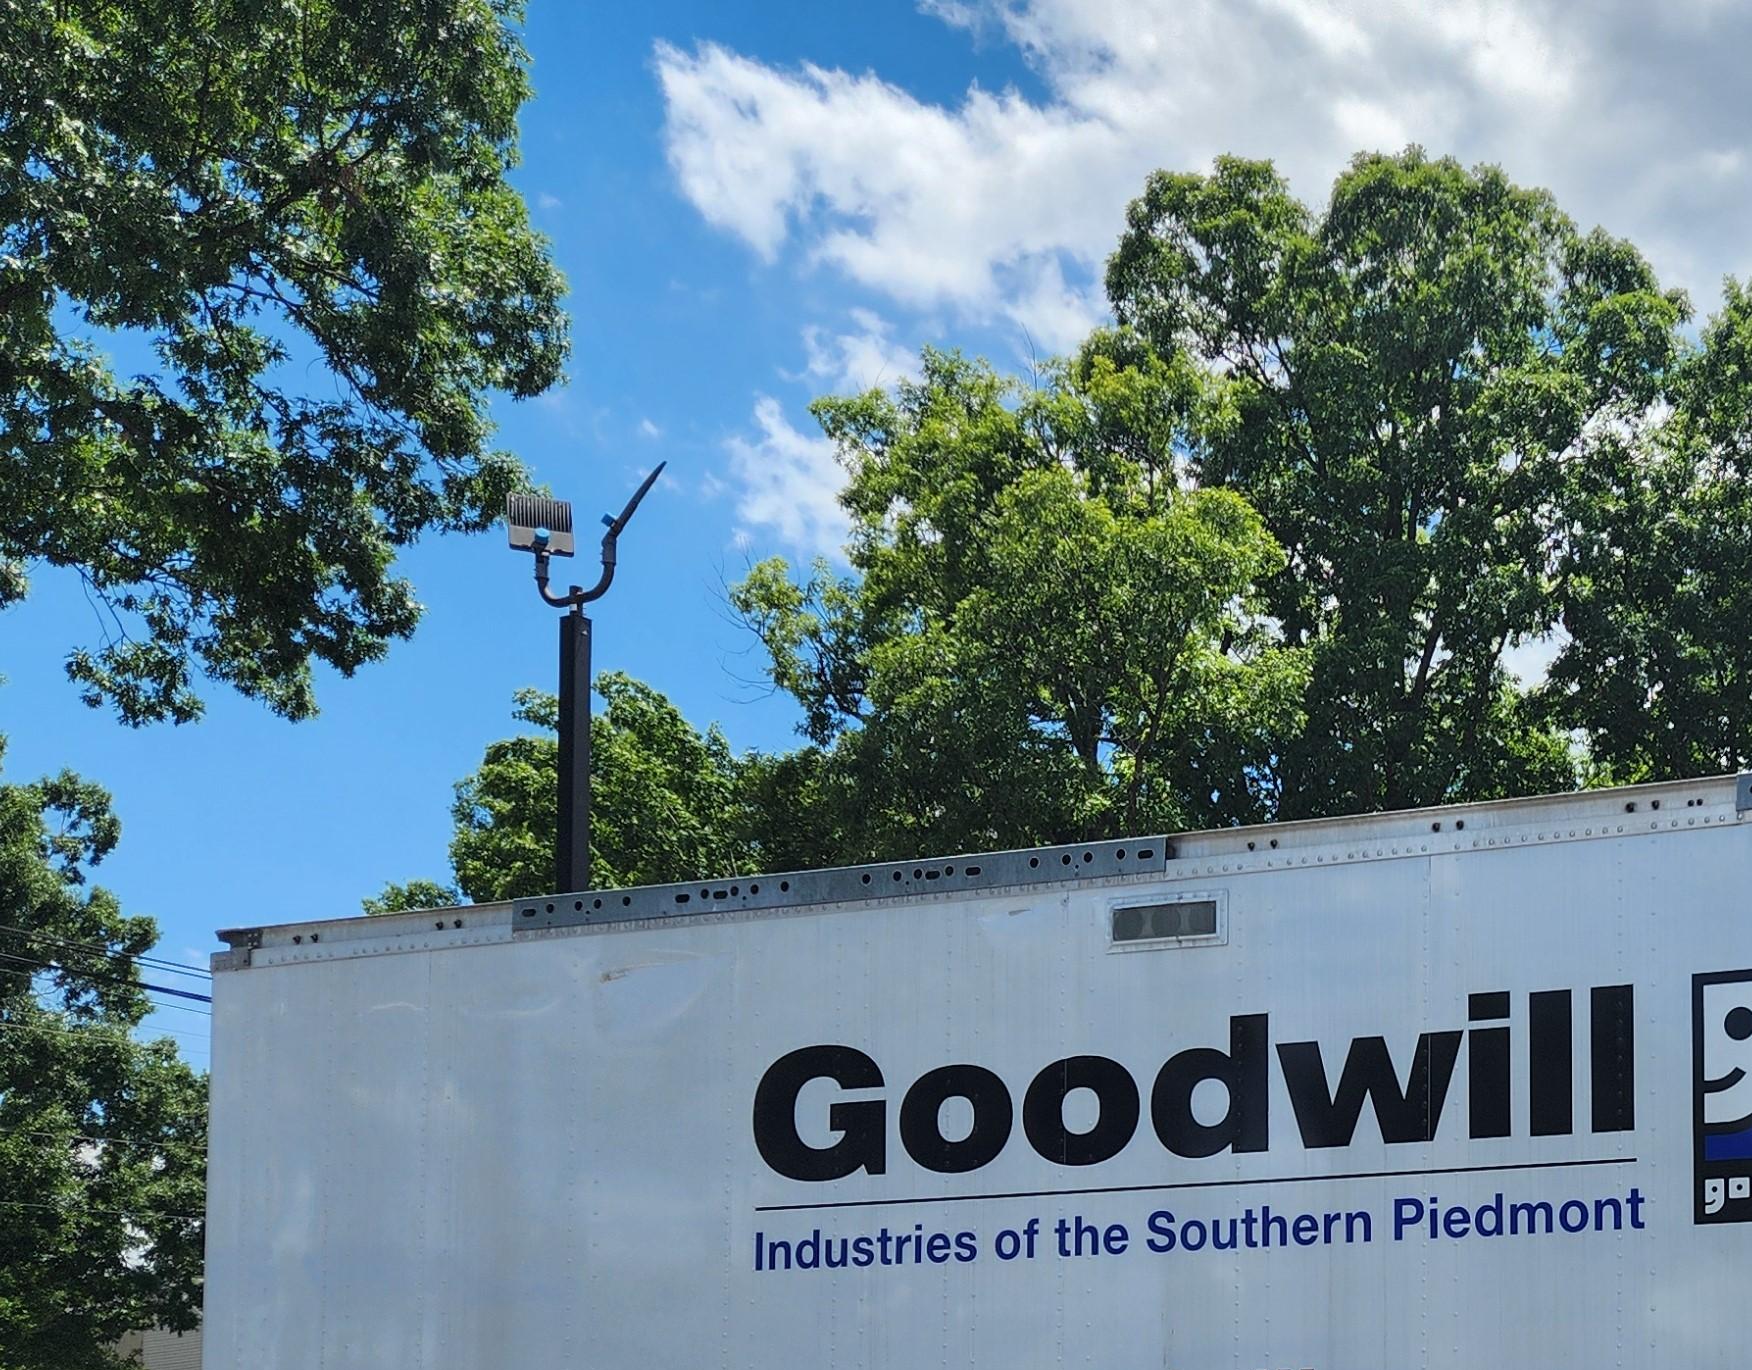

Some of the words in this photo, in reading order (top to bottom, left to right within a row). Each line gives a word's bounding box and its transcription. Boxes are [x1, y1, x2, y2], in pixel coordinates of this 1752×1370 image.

[752, 984, 1635, 1182] Goodwill
[754, 1223, 978, 1271] Industries
[994, 1218, 1039, 1260] of
[1055, 1216, 1129, 1257] the
[1146, 1204, 1372, 1253] Southern
[1393, 1188, 1645, 1242] Piedmont
